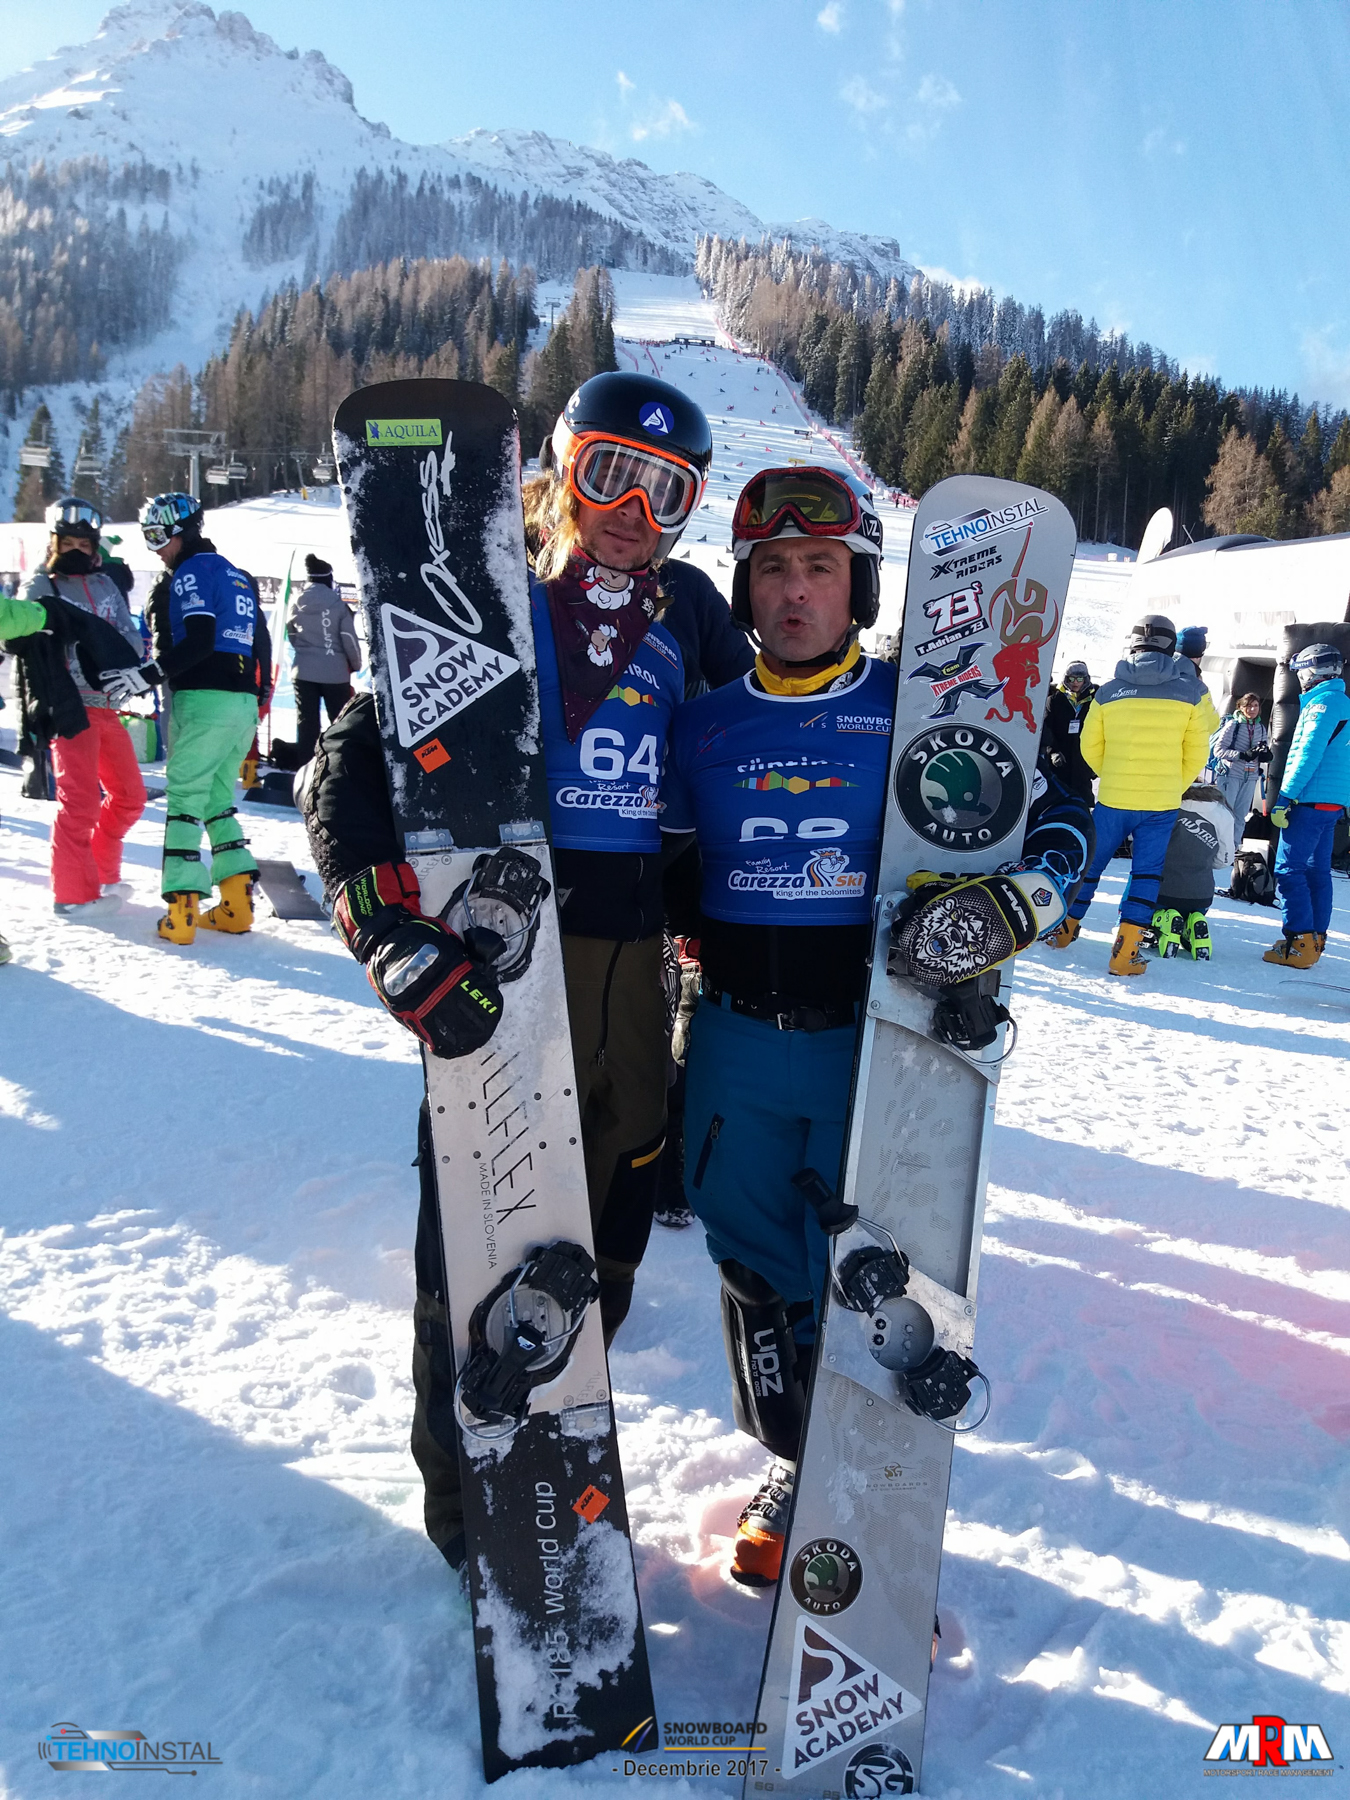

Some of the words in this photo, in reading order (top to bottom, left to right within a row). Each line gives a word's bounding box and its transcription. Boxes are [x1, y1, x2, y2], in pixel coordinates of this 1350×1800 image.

[384, 425, 438, 439] AQUILA
[931, 498, 1046, 549] TEHNOINSTAL
[929, 545, 997, 580] XTREME
[955, 555, 1003, 579] RIDERS
[174, 573, 199, 597] 62
[235, 594, 255, 619] 62
[401, 643, 477, 708] SNOW
[623, 663, 660, 690] IROL
[407, 656, 504, 738] ACADEMY
[836, 715, 892, 726] SNOWBO
[836, 723, 874, 732] WORLD
[580, 727, 660, 785] 64
[909, 728, 1015, 778] SKODA
[923, 822, 992, 845] AUTO
[1177, 817, 1219, 847] AUSTRIA
[730, 872, 806, 889] Carezza
[835, 874, 863, 887] Ski
[776, 889, 794, 898] King
[798, 888, 805, 897] of
[806, 888, 819, 897] the
[821, 888, 862, 897] Dolomites
[354, 884, 368, 916] RACING
[460, 980, 498, 1014] LEKI
[479, 1162, 491, 1196] MADE
[482, 1198, 493, 1211] IN
[483, 1213, 498, 1270] SLOVENIA
[801, 1541, 858, 1572] SKODA
[537, 1538, 566, 1615] World
[804, 1597, 841, 1612] AUTO
[796, 1673, 879, 1736] SNOW
[795, 1692, 904, 1769] ACADEMY
